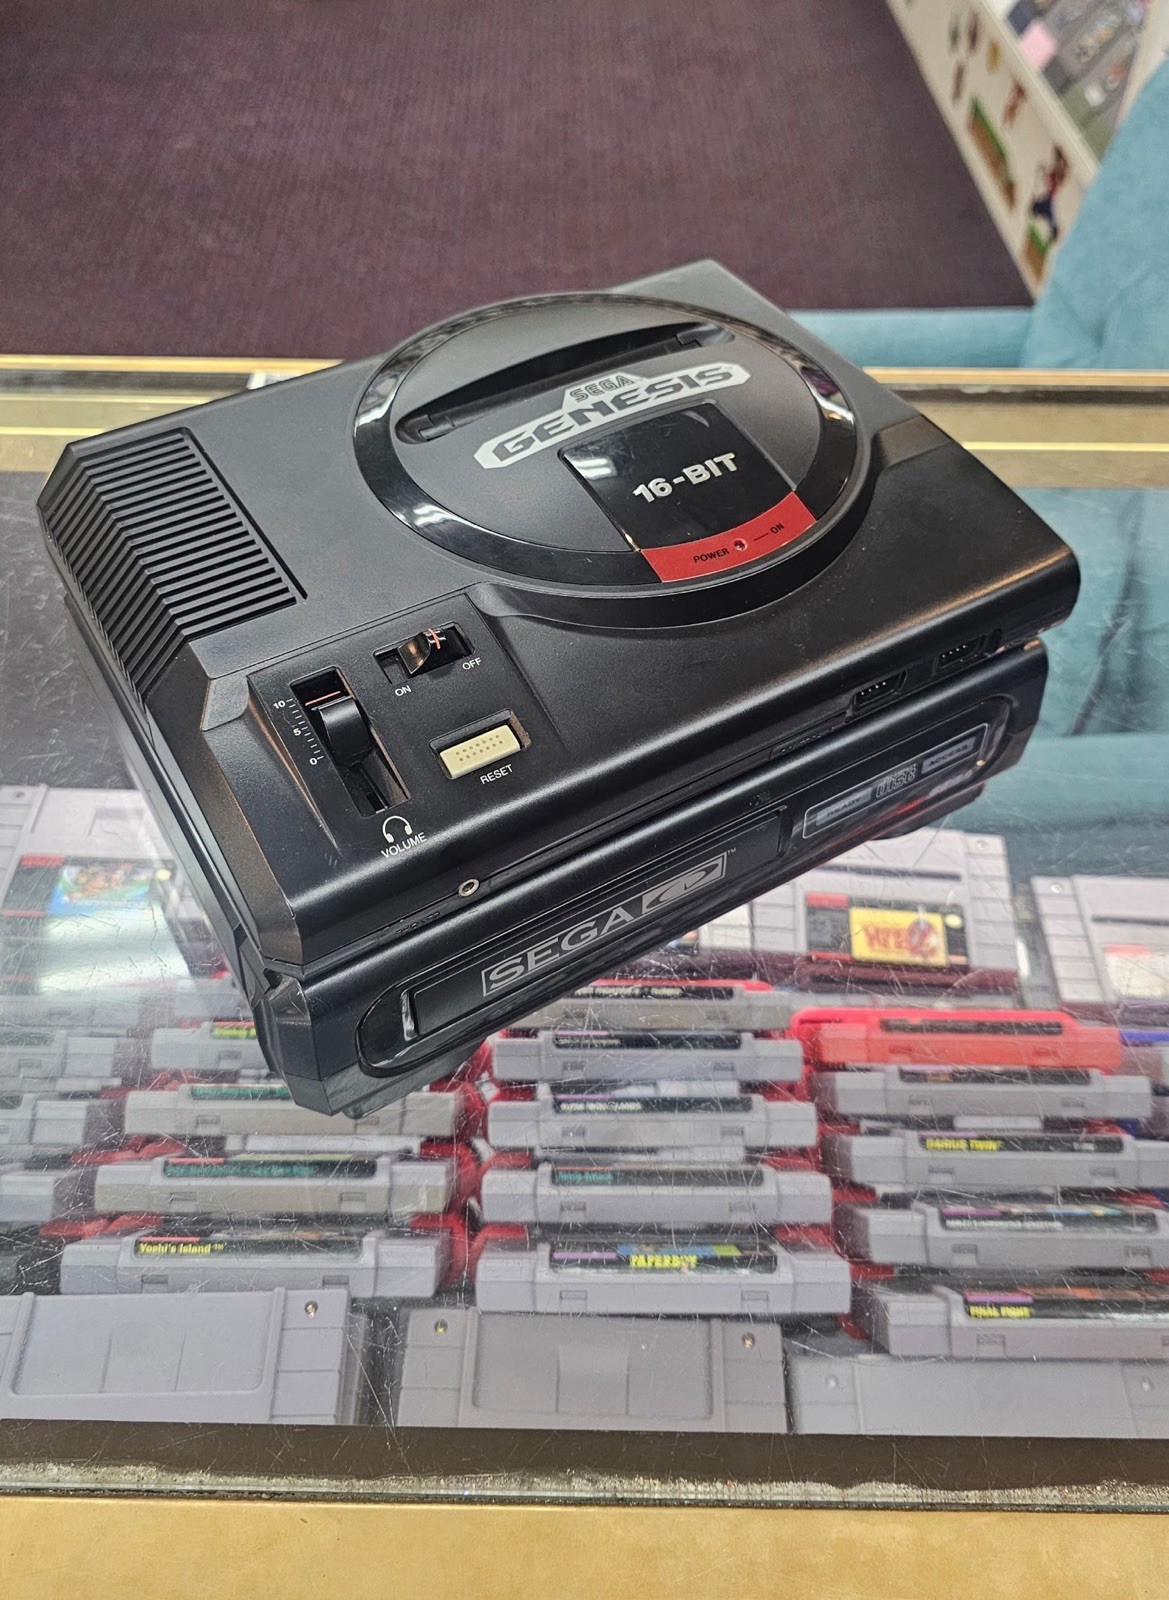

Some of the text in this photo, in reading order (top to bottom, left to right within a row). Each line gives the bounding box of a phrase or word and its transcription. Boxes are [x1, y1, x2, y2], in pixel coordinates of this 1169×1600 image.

[569, 374, 636, 402] SEGA
[492, 367, 734, 462] GENESIS
[632, 452, 736, 503] 16-BIT
[693, 523, 785, 563] POWER ON
[462, 657, 483, 671] OFF
[394, 685, 412, 697] ON
[273, 700, 286, 710] 10
[293, 728, 302, 736] 5
[309, 757, 318, 766] 0
[479, 764, 514, 785] RESET
[380, 831, 429, 859] VOLUME
[489, 906, 634, 988] SEGA
[140, 1243, 177, 1254] Yoshi's
[179, 1243, 211, 1254] Island
